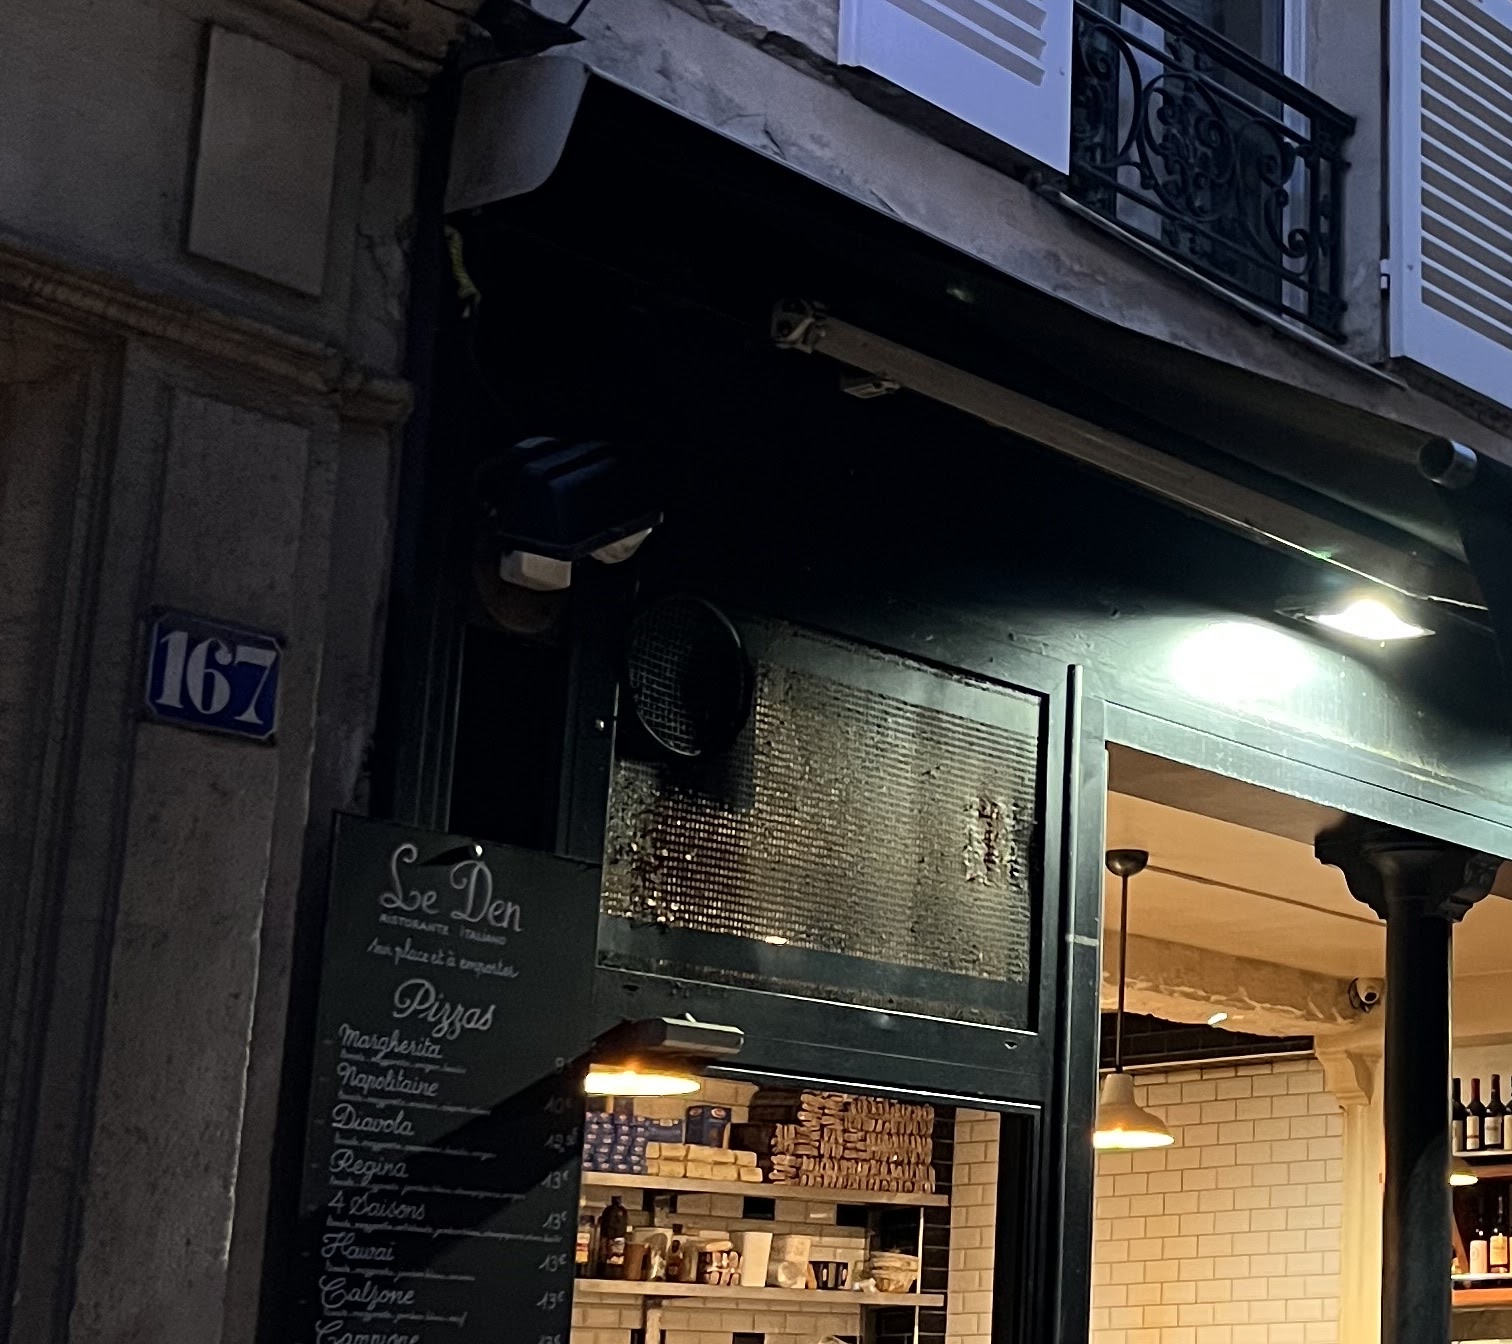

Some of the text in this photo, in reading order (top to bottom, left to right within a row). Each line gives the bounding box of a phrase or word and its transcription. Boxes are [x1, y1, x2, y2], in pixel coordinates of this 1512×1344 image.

[155, 630, 277, 725] 167
[379, 842, 523, 933] Le Den
[392, 978, 497, 1041] Pizzas
[337, 1022, 444, 1060] Margherita
[336, 1061, 440, 1097] Napolitaine
[331, 1102, 416, 1136] Diavola
[328, 1147, 410, 1186] Regina
[327, 1189, 346, 1215] 4
[349, 1194, 426, 1221] Saisons
[541, 1210, 568, 1231] 13€
[538, 1253, 568, 1273] 13€
[318, 1274, 566, 1311] Calzone 13€
